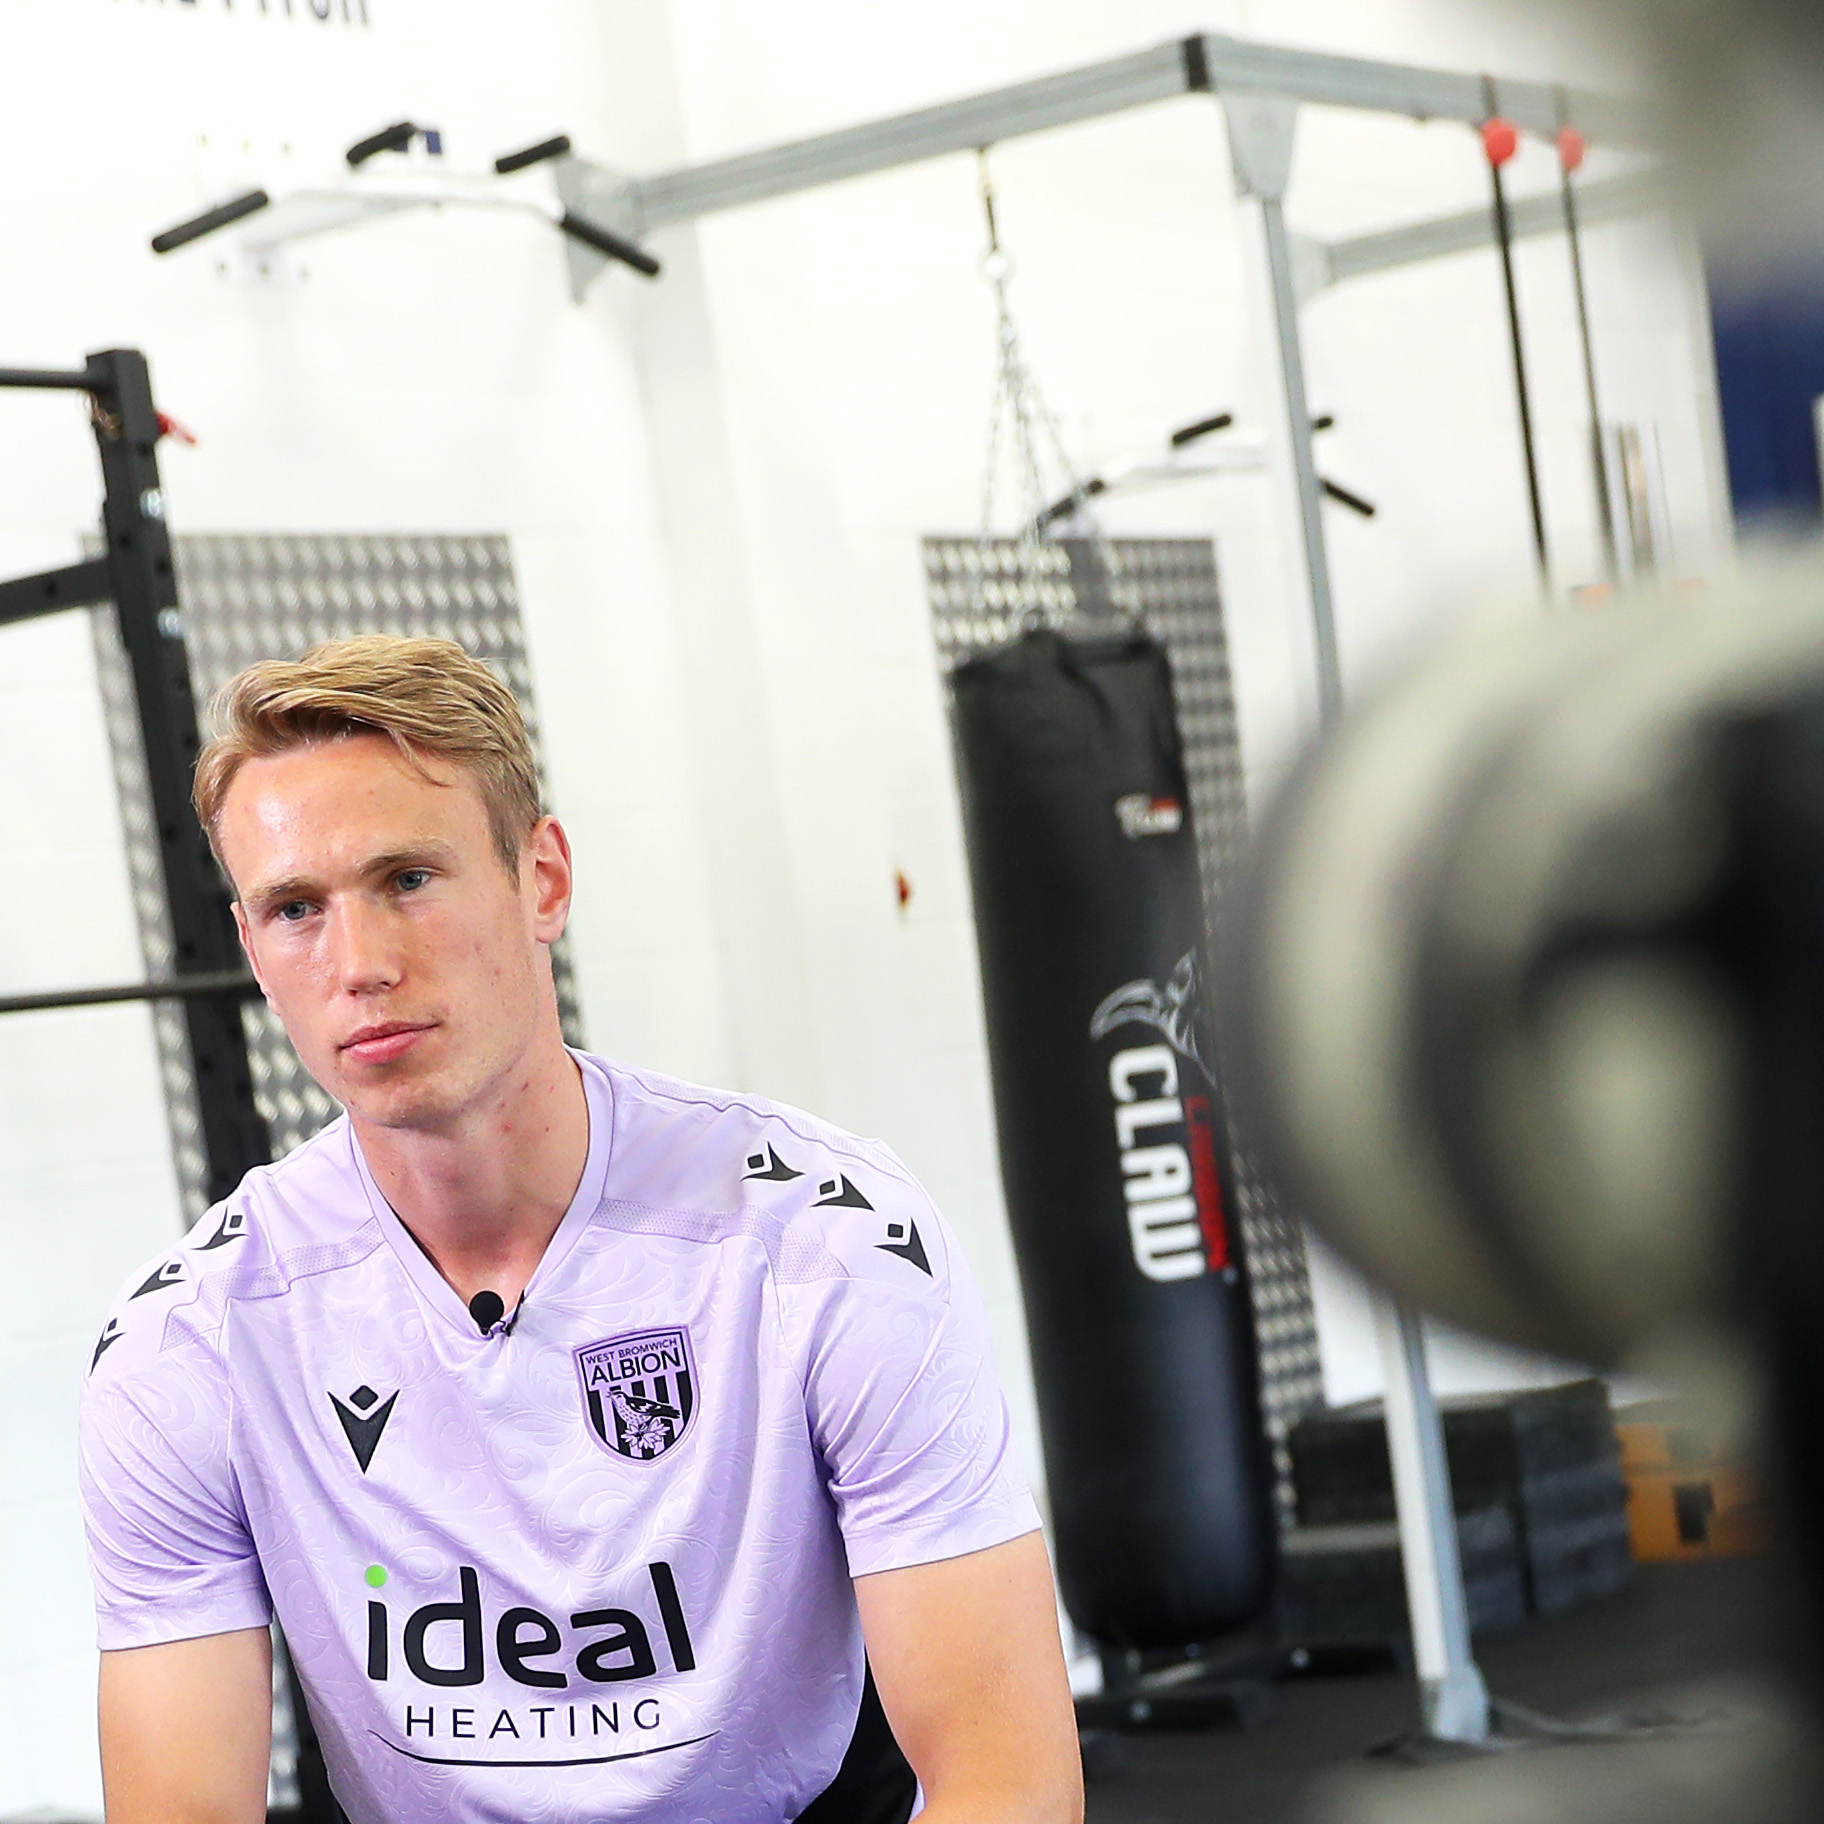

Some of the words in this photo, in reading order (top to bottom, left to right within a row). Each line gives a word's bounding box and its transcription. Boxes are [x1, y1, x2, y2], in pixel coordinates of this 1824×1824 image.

[1109, 1044, 1206, 1282] CLAW
[587, 1352, 614, 1364] WEST
[619, 1339, 676, 1357] BROMWICH
[592, 1348, 680, 1385] ALBION
[365, 1561, 696, 1689] ideal
[406, 1699, 662, 1739] HEATING
